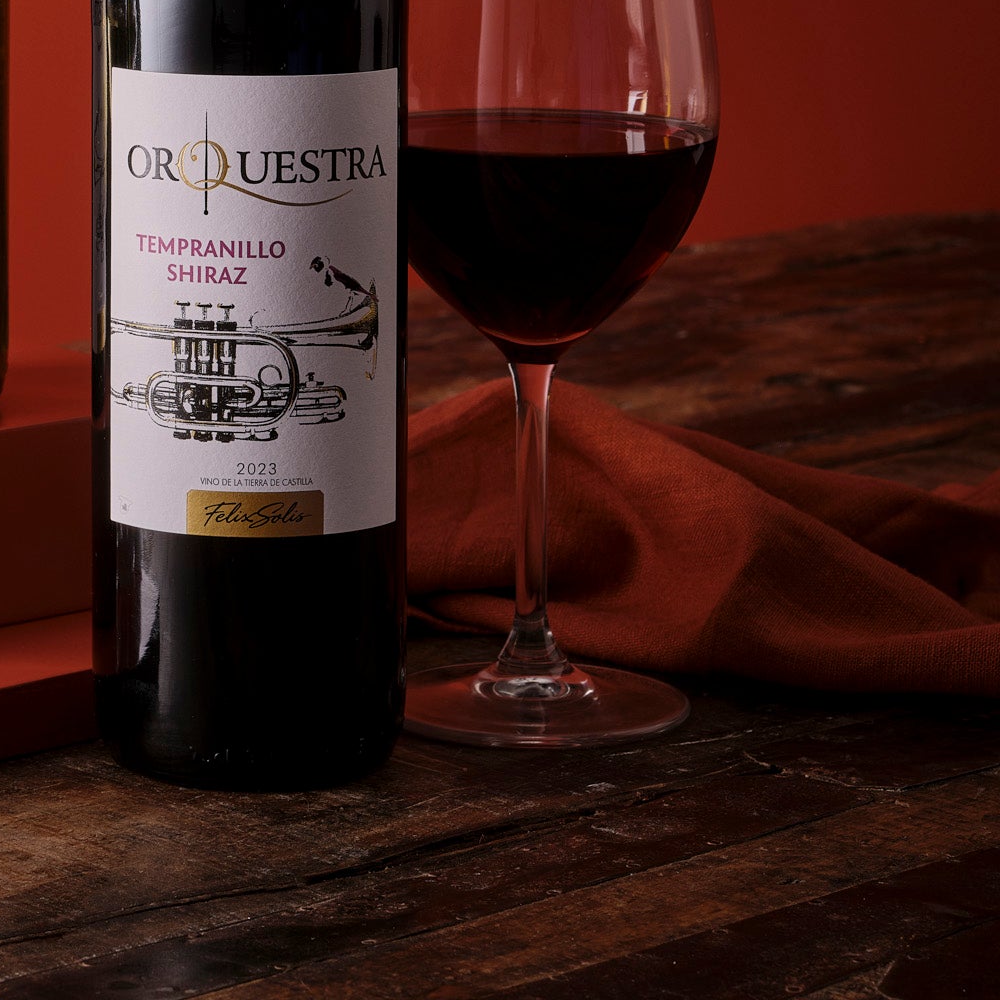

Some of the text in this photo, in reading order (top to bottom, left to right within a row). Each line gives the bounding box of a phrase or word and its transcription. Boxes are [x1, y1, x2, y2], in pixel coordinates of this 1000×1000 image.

[127, 140, 387, 206] ORQUESTRA
[136, 233, 286, 259] TEMPRANILLO
[167, 263, 248, 285] SHIRAZ
[236, 462, 277, 475] 2023
[200, 477, 313, 487] VINO DE LA TIERRA DE CASTILLA
